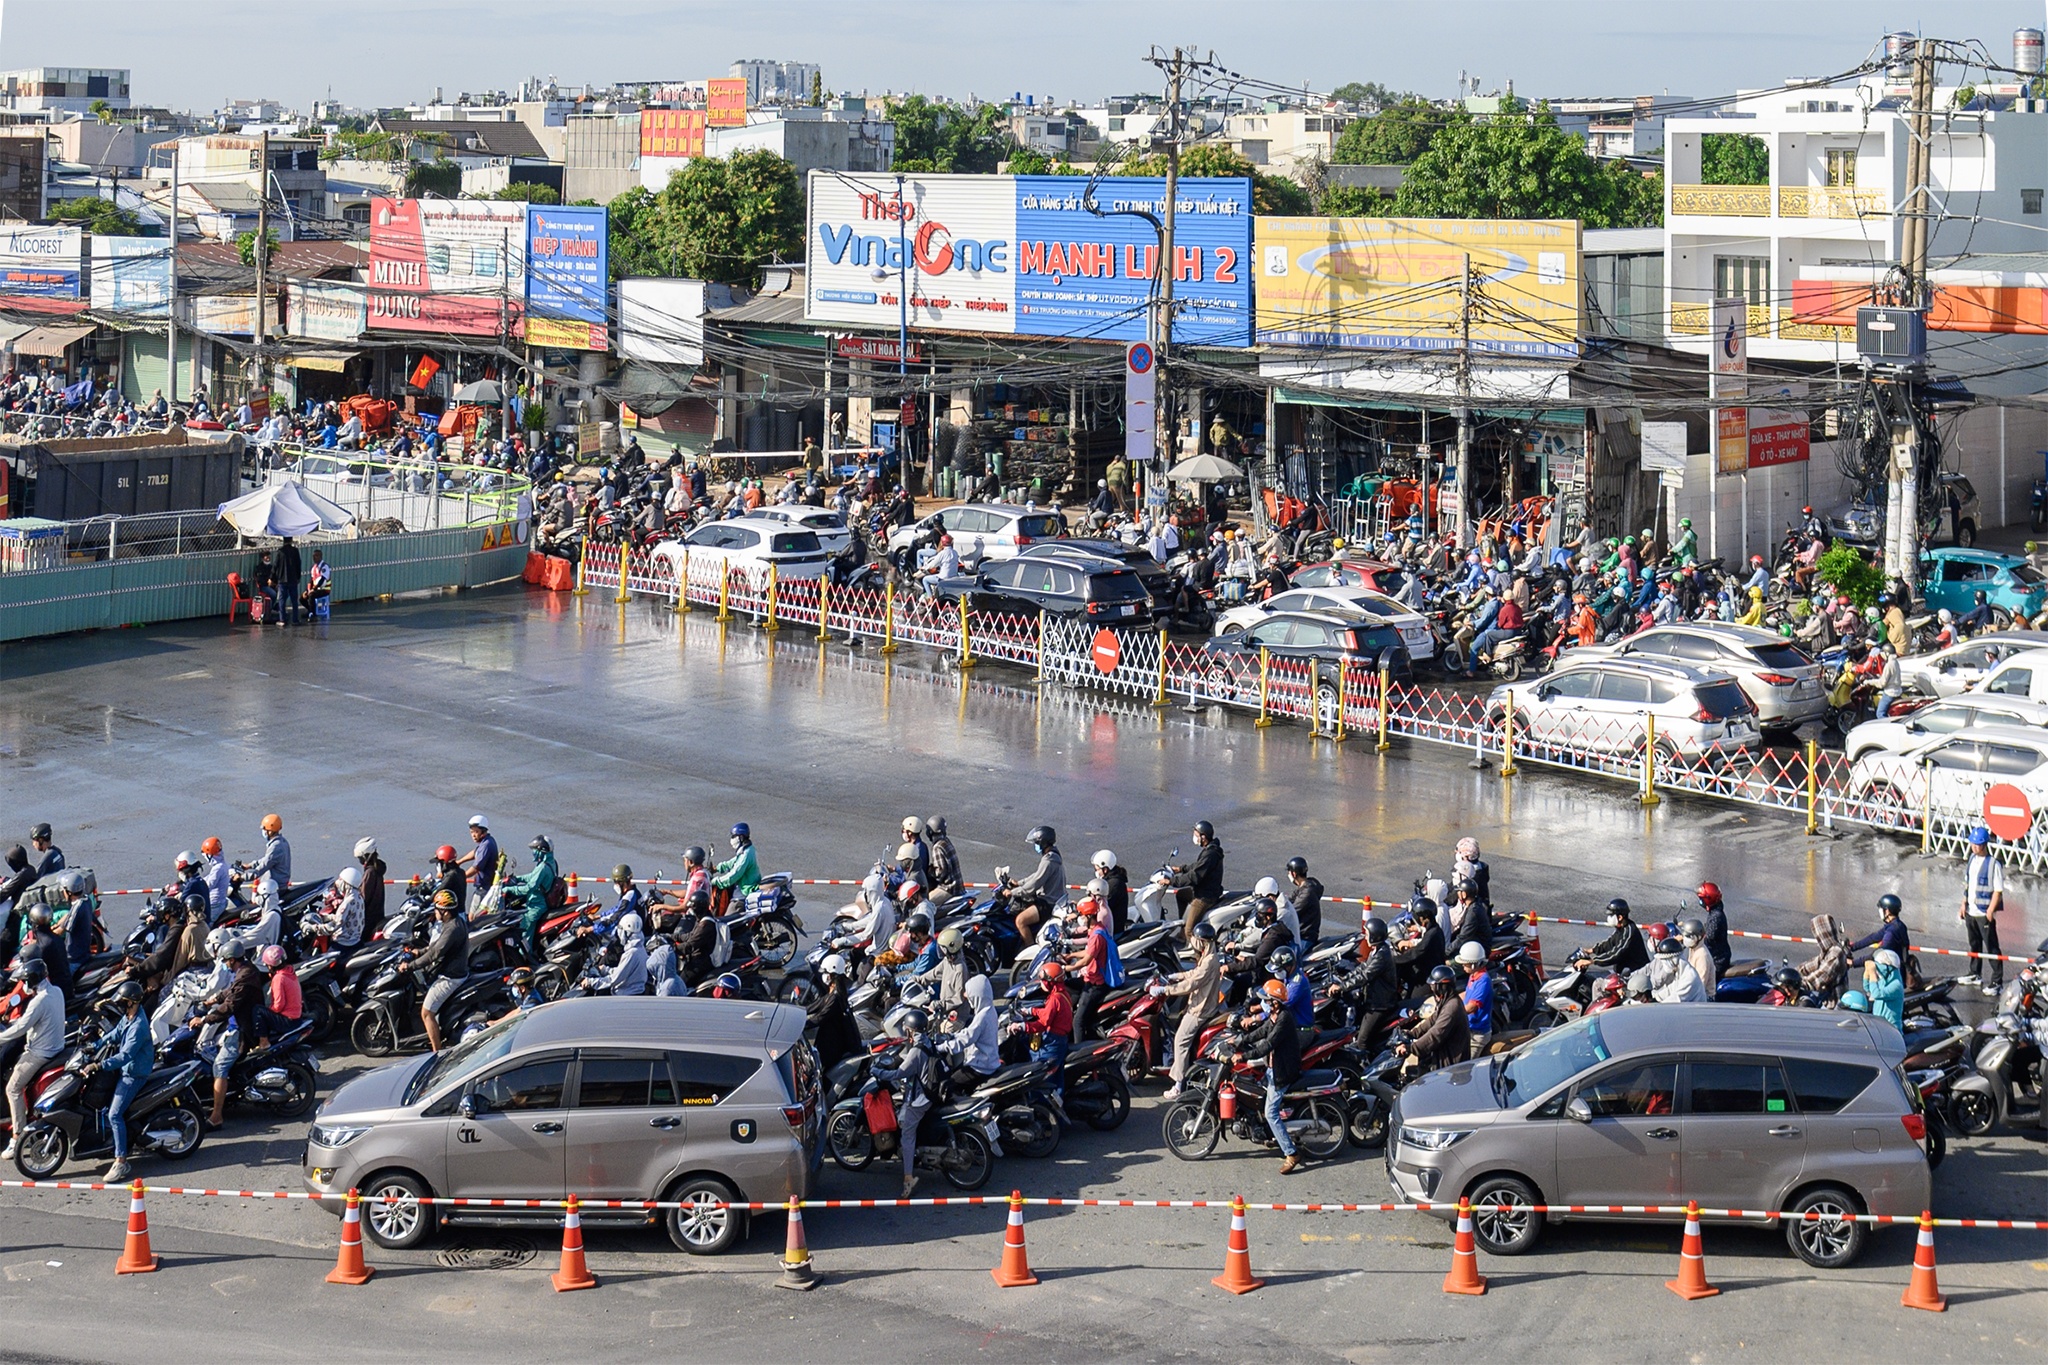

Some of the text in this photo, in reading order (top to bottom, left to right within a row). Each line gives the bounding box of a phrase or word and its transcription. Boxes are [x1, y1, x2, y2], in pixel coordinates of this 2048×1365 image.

[1020, 240, 1115, 286] MẠNH
[1214, 246, 1237, 283] 2
[374, 260, 422, 285] MINH
[1751, 431, 1763, 444] RỬA
[1765, 433, 1772, 443] XE
[1776, 430, 1790, 441] THAY
[1778, 448, 1785, 458] XE
[118, 477, 129, 488] 51L
[148, 475, 169, 486] 770.23
